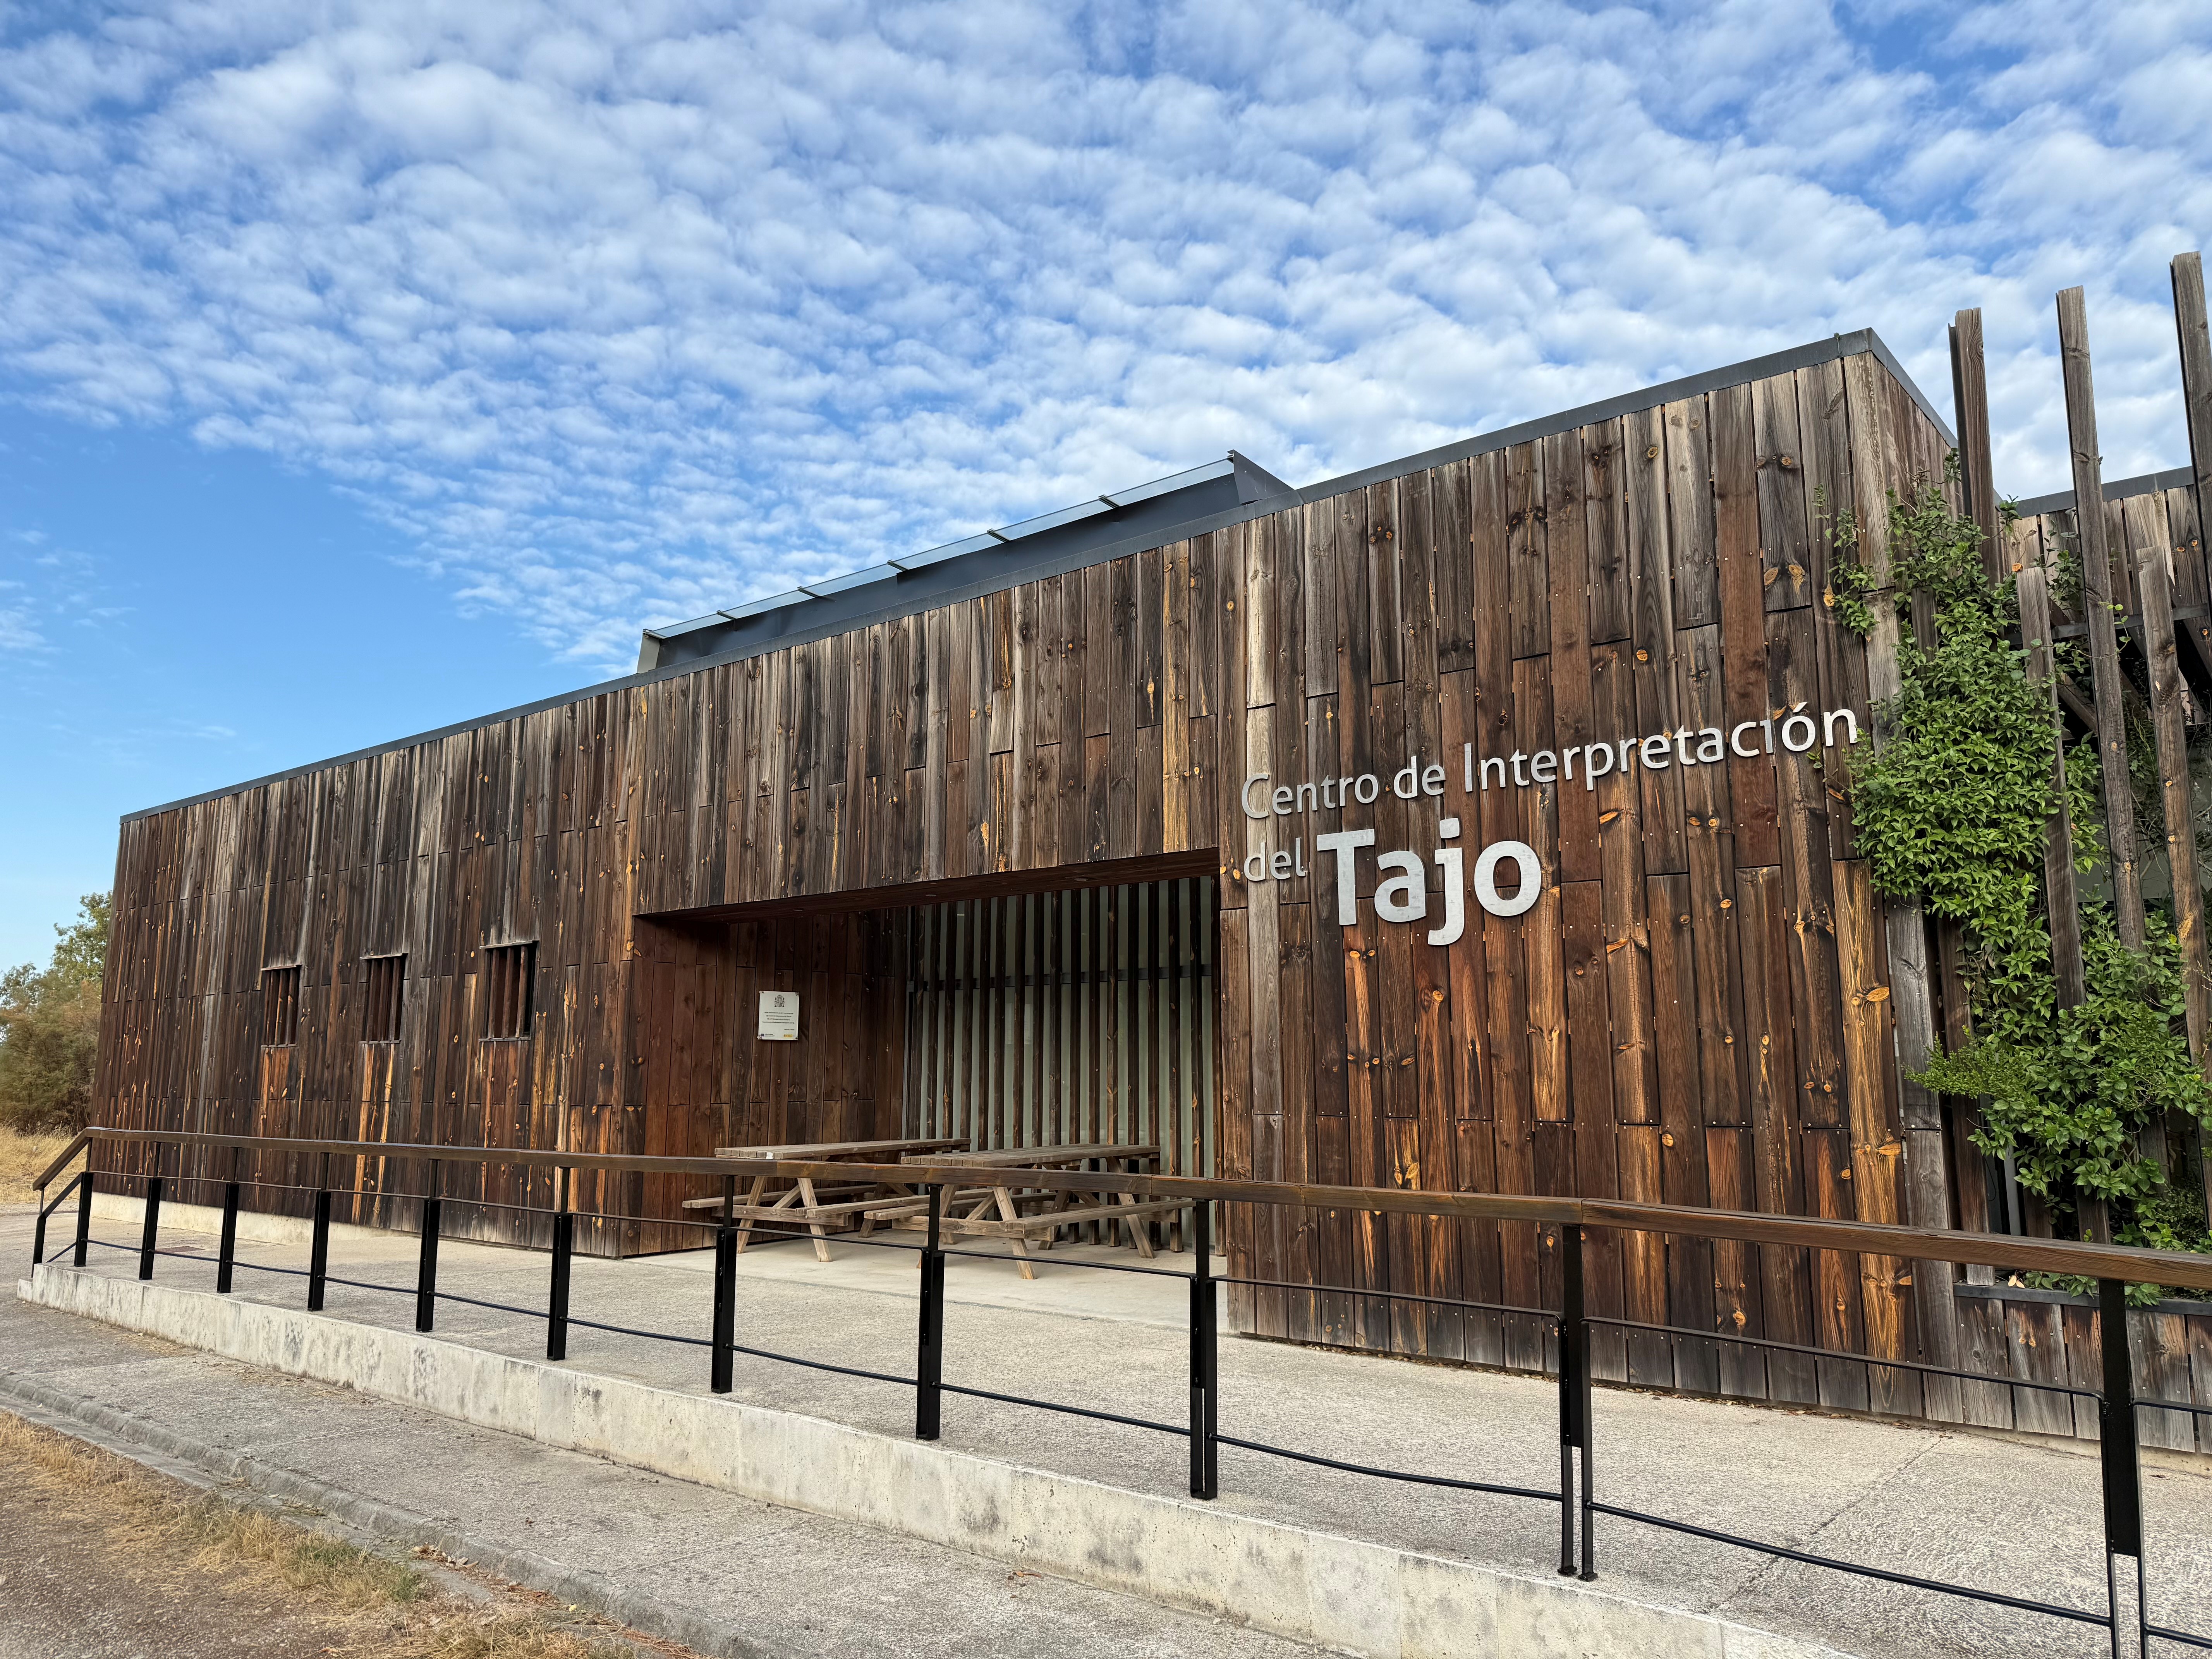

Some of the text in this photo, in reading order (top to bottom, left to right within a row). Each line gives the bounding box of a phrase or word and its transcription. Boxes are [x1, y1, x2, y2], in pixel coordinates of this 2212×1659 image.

[1242, 701, 1858, 819] Centro de Interpretación
[1244, 817, 1542, 945] del Tajo
